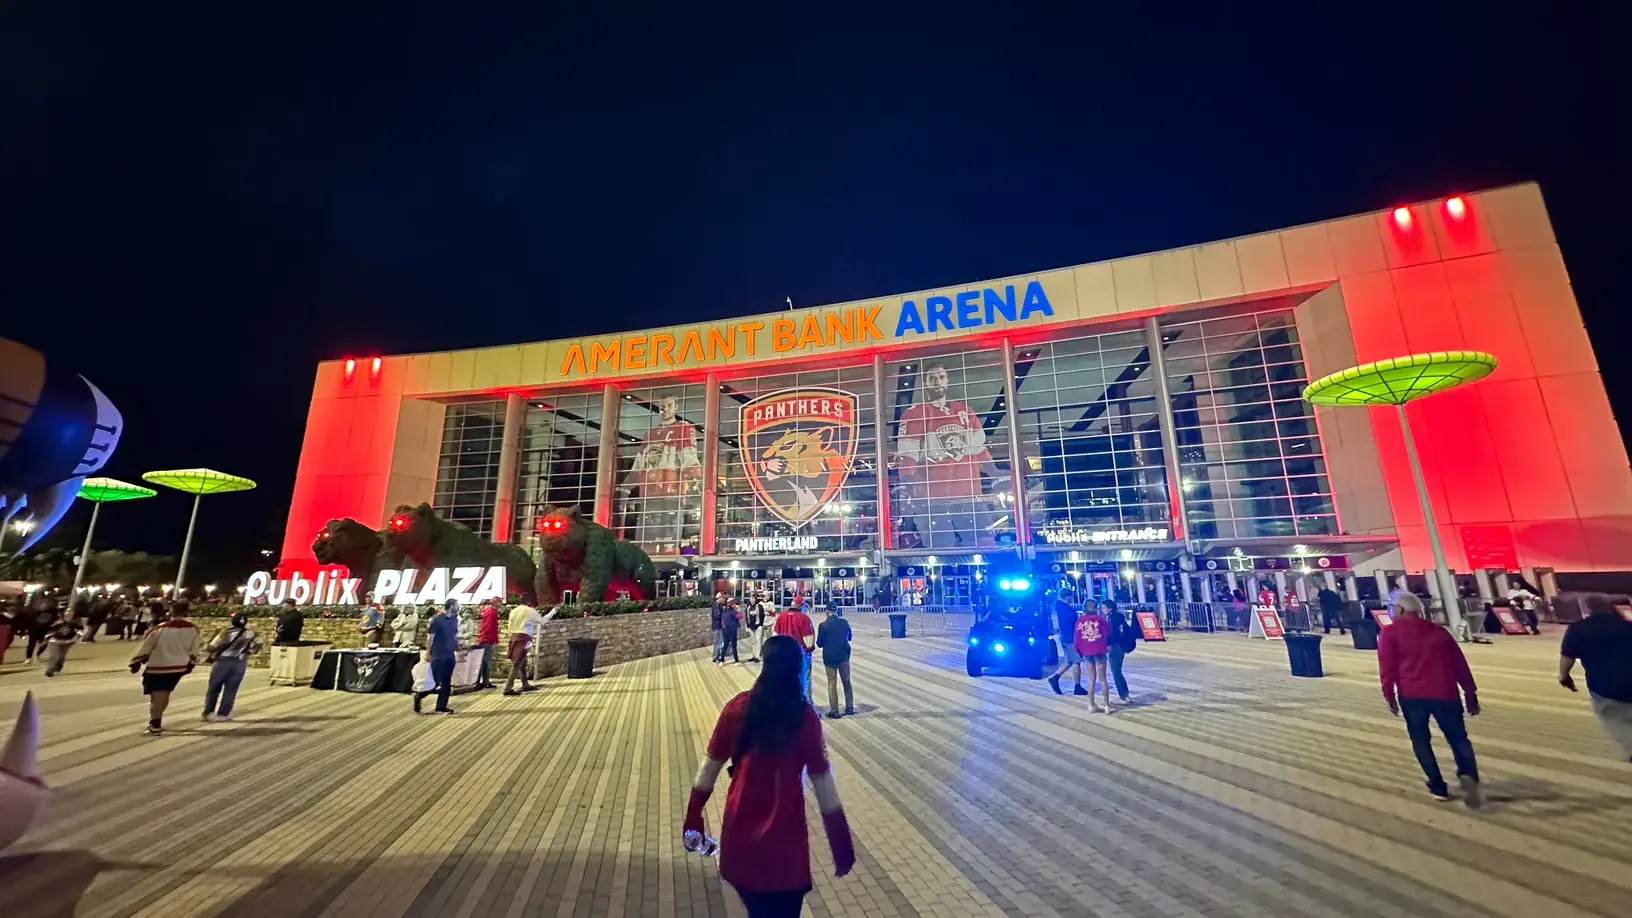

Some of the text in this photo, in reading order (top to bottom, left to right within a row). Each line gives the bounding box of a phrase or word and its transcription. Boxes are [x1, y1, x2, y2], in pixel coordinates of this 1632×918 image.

[560, 280, 1055, 376] AMERANT BANK ARENA
[753, 398, 844, 426] PANTHERS
[735, 535, 819, 551] PANTHERLAND
[243, 566, 507, 605] Publix PLAZA
